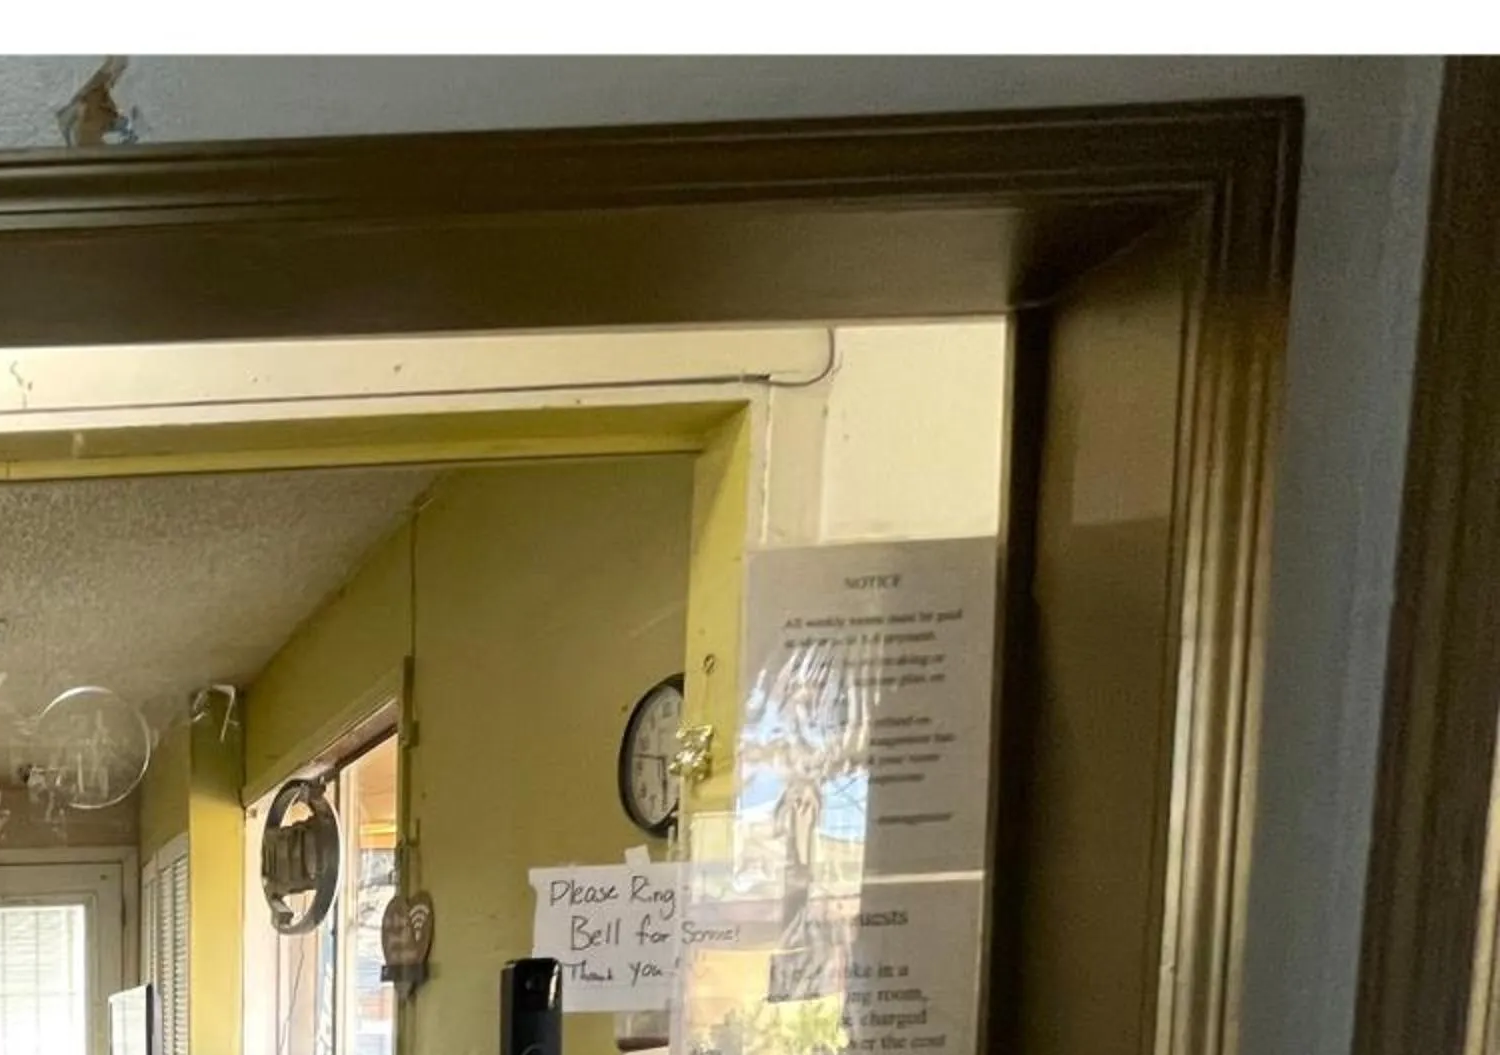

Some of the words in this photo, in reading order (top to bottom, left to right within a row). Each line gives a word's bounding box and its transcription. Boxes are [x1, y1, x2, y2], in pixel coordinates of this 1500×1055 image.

[843, 574, 902, 589] NOTICE
[549, 879, 618, 907] Please
[571, 915, 621, 951] Bell
[635, 914, 672, 946] for
[860, 1009, 929, 1030] charged
[881, 1035, 907, 1050] the
